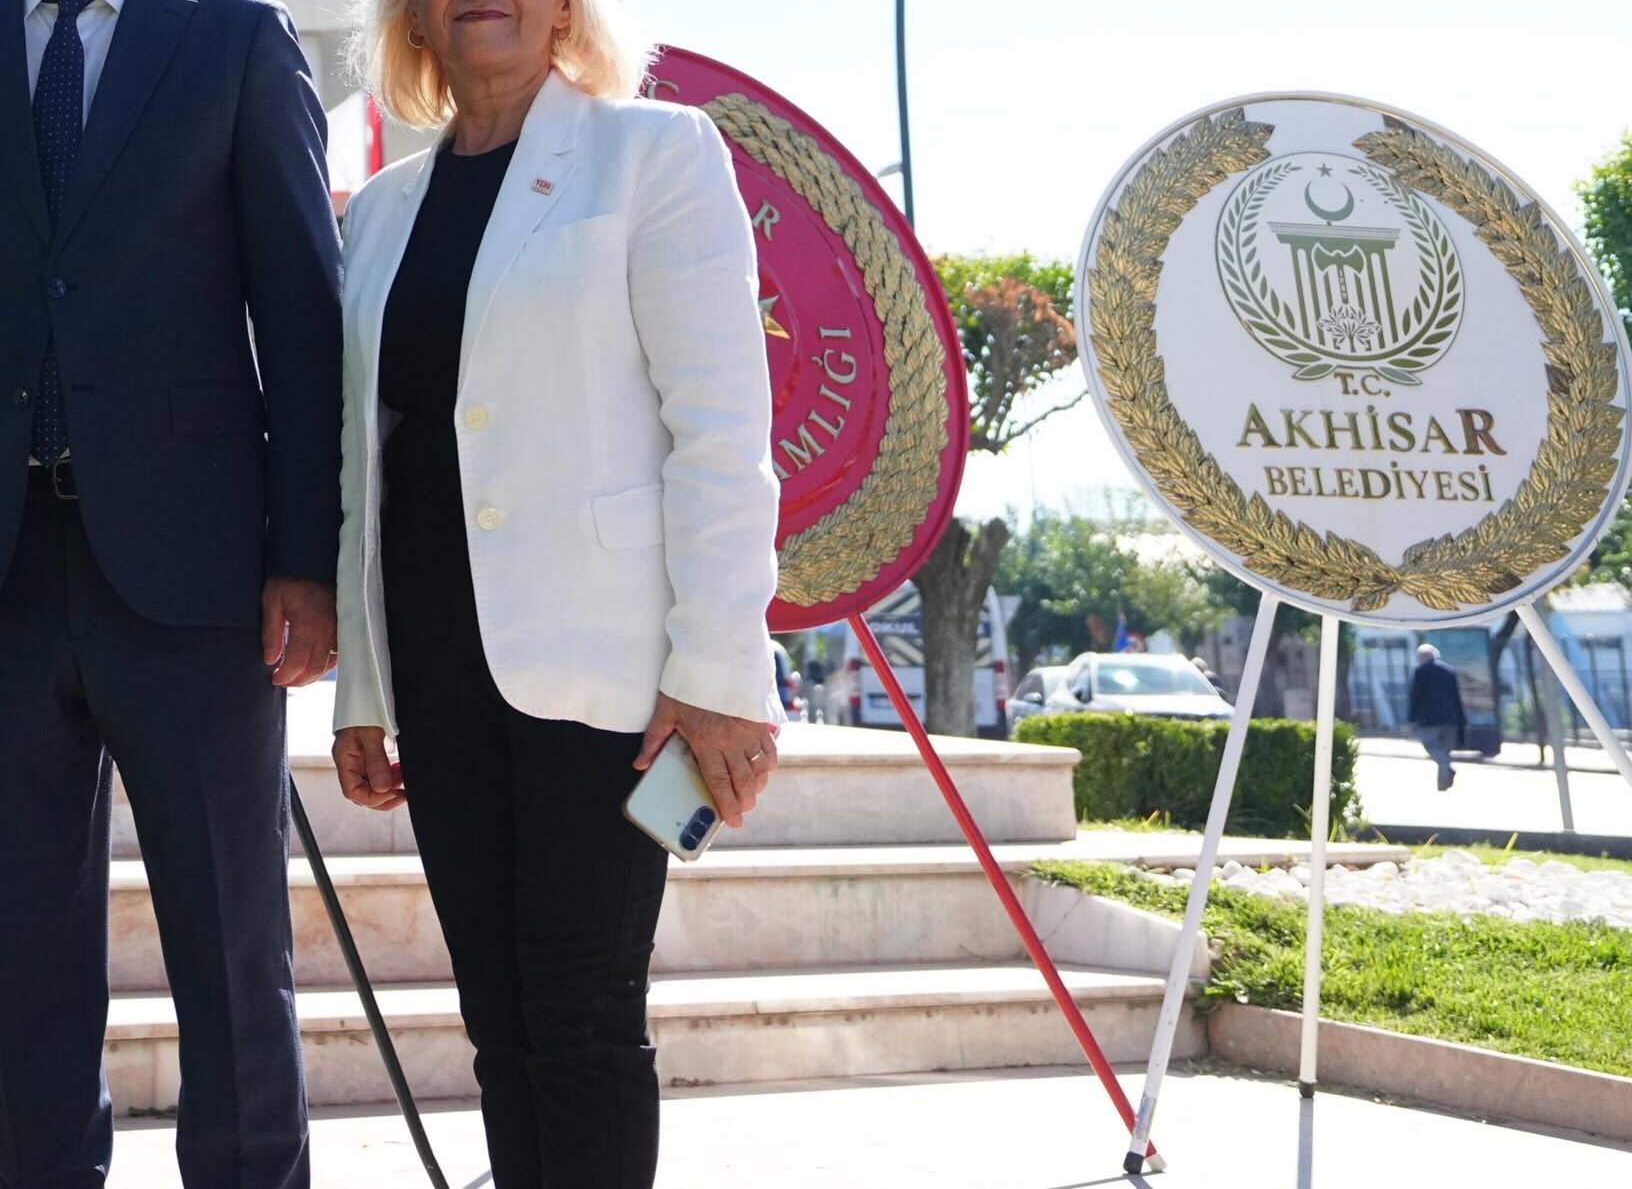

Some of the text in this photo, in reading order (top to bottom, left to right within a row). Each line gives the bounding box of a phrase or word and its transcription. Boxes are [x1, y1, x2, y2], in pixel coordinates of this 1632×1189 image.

[1334, 372, 1391, 397] T.C.
[1236, 403, 1507, 456] AKHİSAR
[1263, 461, 1495, 502] BELEDİYESİ
